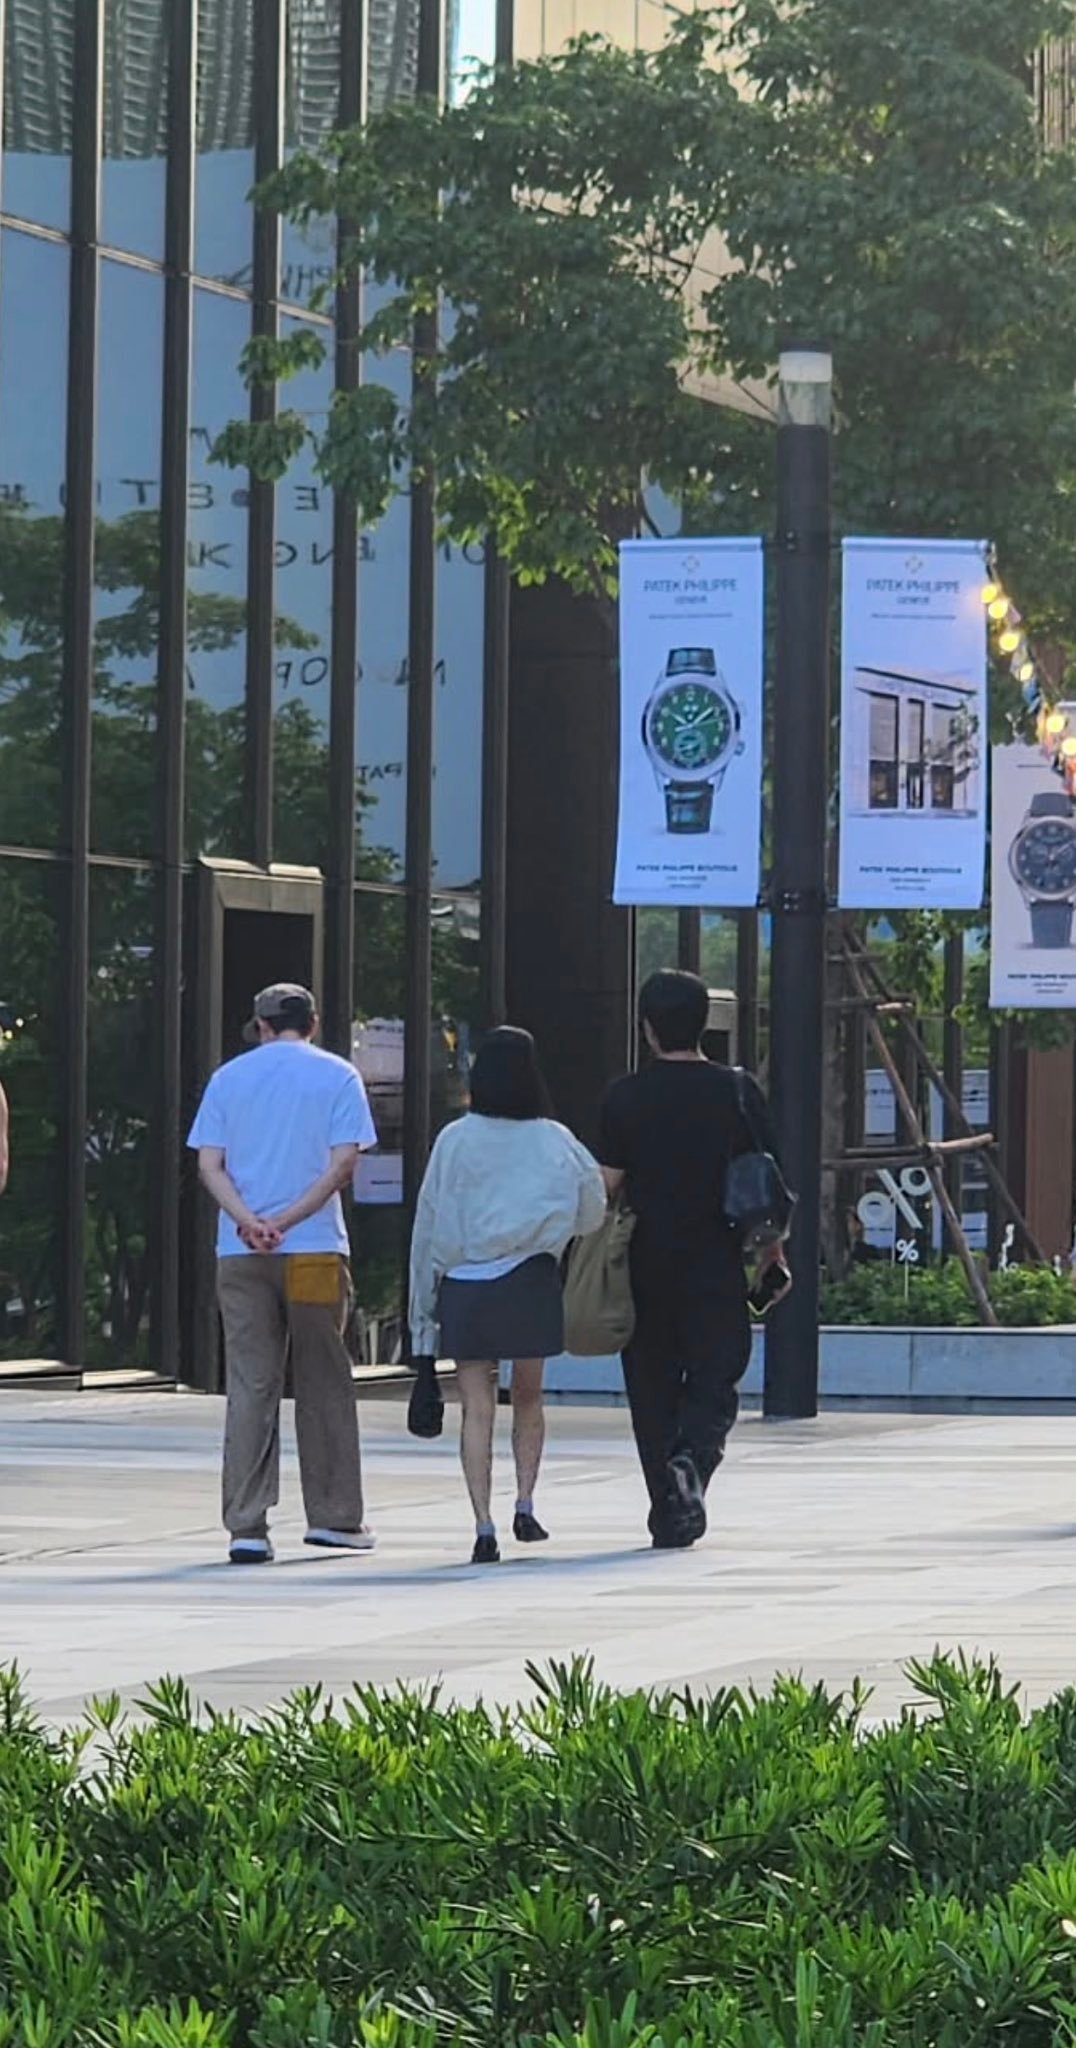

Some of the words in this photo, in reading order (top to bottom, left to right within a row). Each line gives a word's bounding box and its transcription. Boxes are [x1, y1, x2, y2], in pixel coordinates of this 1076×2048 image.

[643, 578, 681, 592] PATEK
[684, 578, 737, 592] PHILIPPE
[866, 579, 902, 593] PATEK
[906, 580, 960, 593] PHILIPPE
